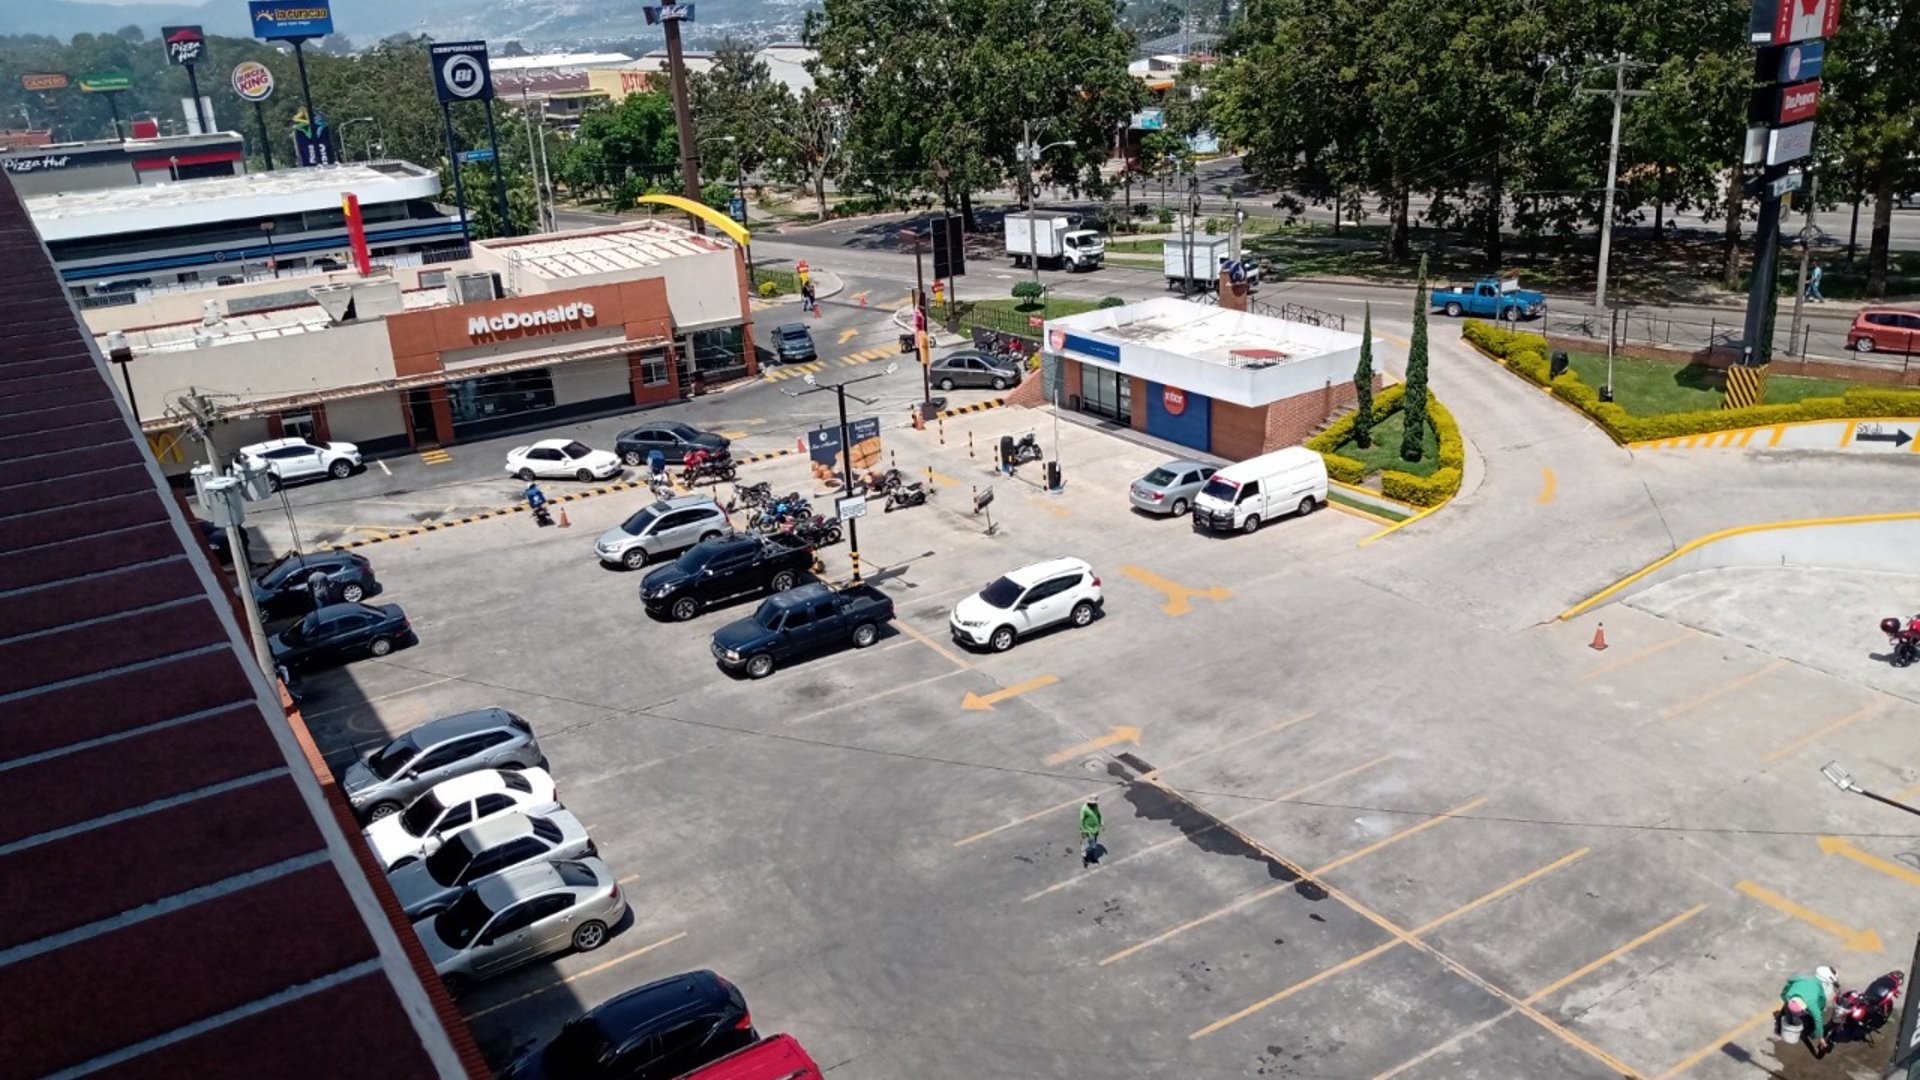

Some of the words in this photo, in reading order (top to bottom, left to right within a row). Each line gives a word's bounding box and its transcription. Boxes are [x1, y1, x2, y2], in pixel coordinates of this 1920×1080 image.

[171, 41, 200, 56] Pizza
[178, 49, 199, 62] Hut
[240, 75, 269, 92] KING
[1, 159, 41, 171] Pizza
[42, 156, 70, 168] Hut
[468, 302, 595, 335] McDonald's
